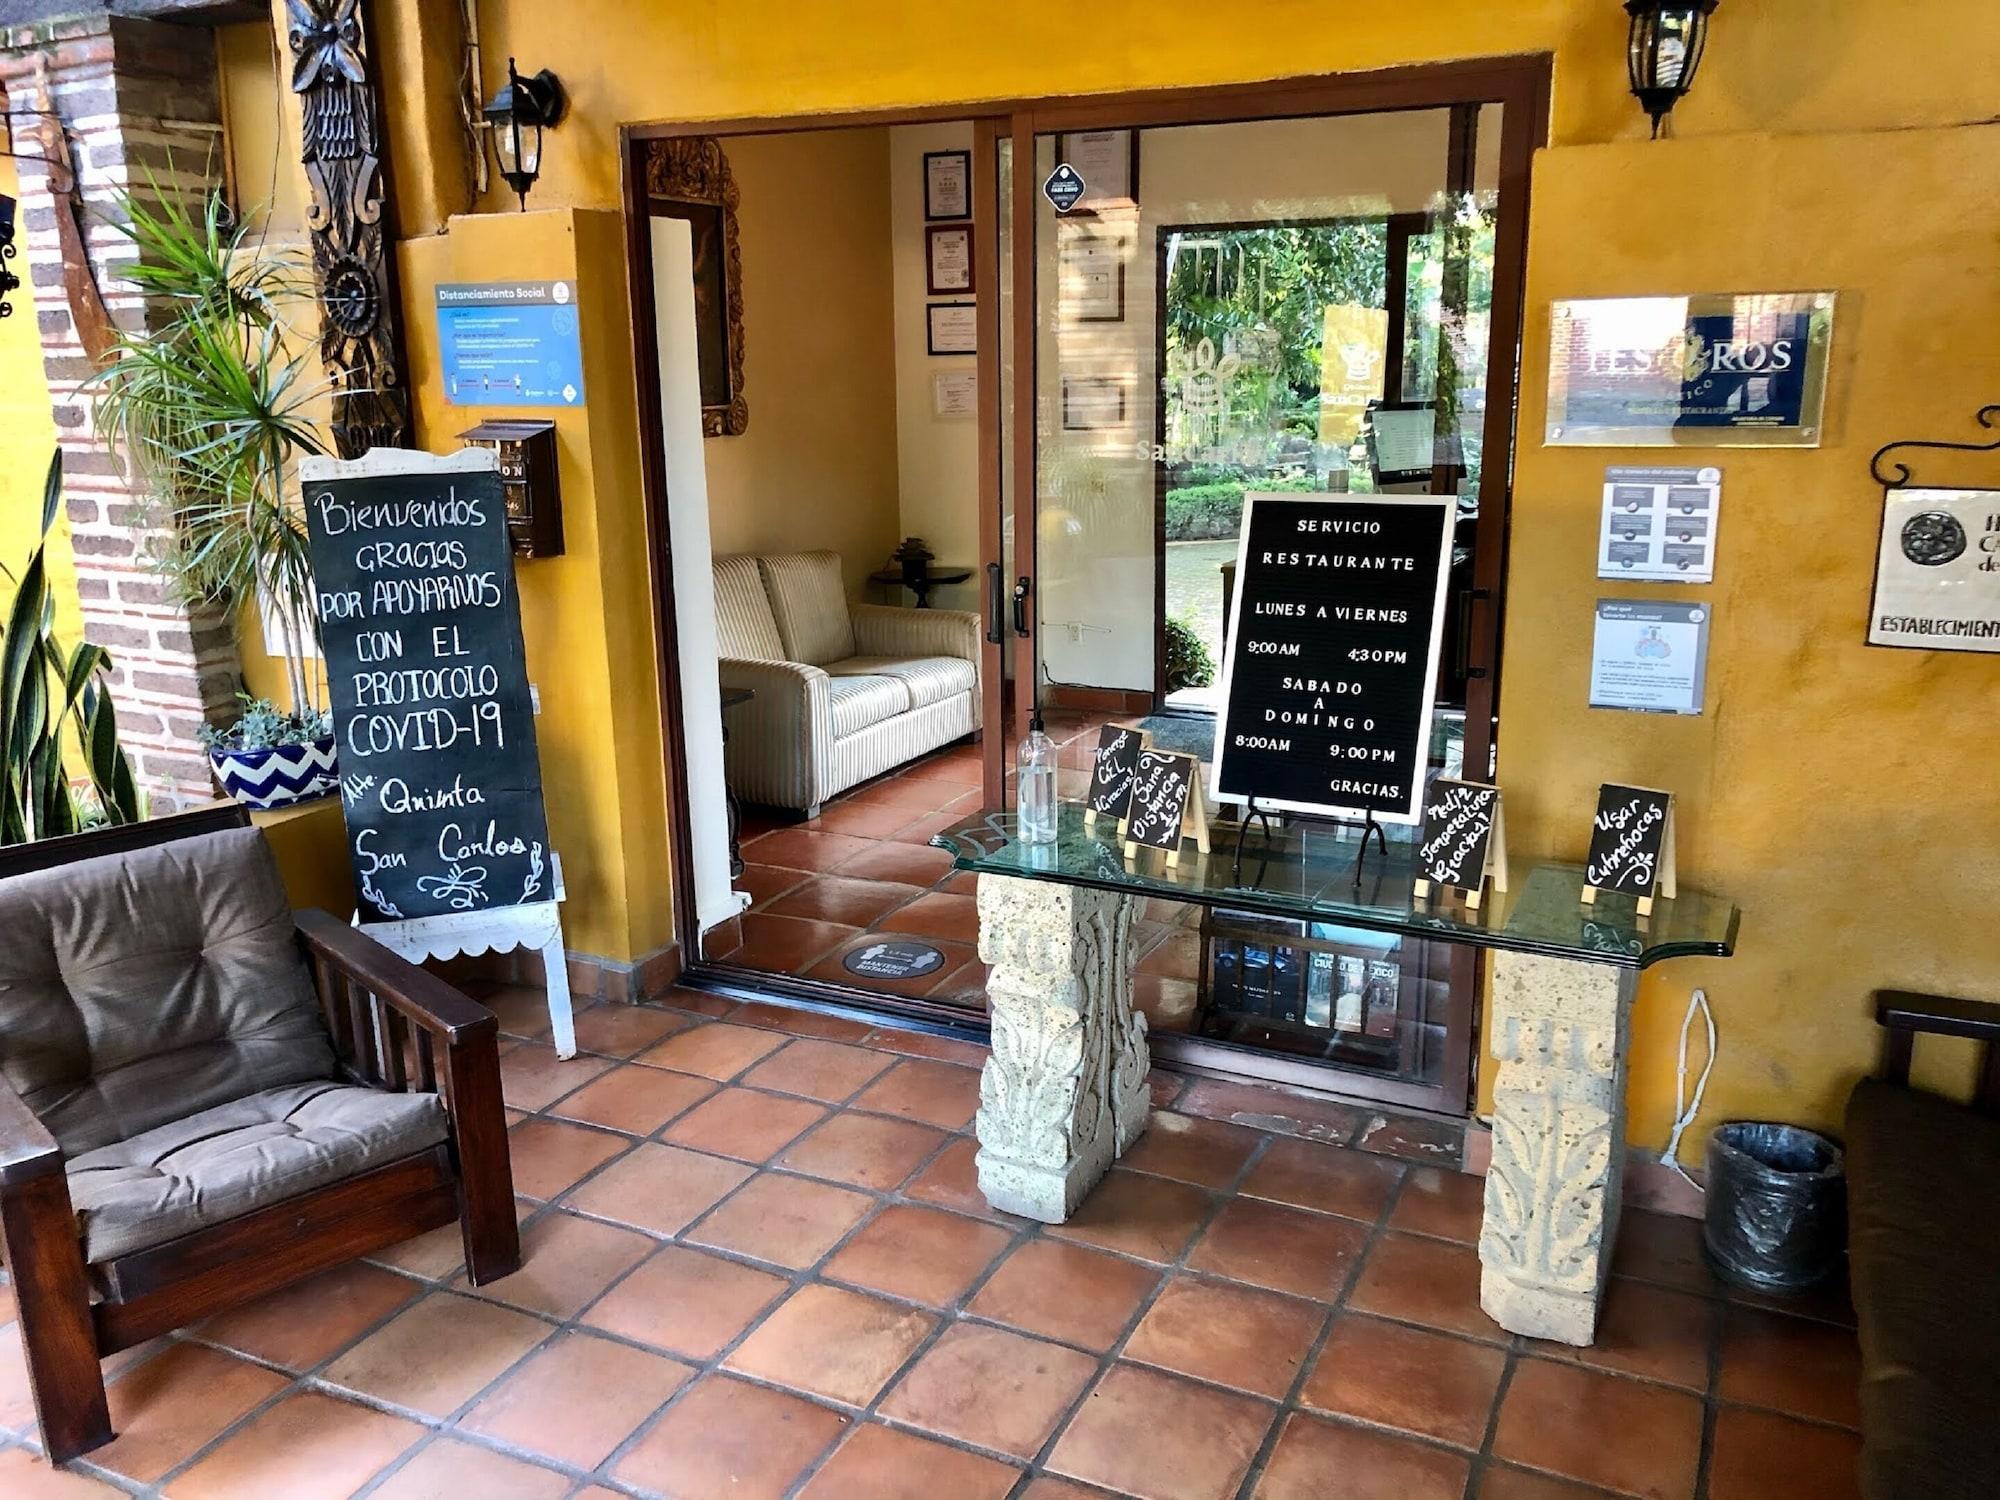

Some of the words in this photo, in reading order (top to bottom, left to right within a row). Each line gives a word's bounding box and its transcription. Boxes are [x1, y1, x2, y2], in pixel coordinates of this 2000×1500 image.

[439, 289, 515, 301] Distanciamiento
[516, 286, 546, 298] Social
[314, 486, 487, 536] Bienvenidos
[1297, 519, 1381, 534] SERVICIO
[1262, 552, 1414, 571] RESTAURANTE
[320, 591, 365, 623] POR
[372, 571, 501, 616] APOYARNOS
[1255, 602, 1306, 616] LUNES
[1317, 605, 1327, 619] A
[1335, 607, 1408, 624] VIERNES
[1879, 615, 2000, 638] ESTABLECIMIENT
[355, 630, 403, 662] CON
[432, 625, 470, 658] EL
[352, 664, 499, 708] PROTOCOLO
[1282, 676, 1362, 695] SABADO
[1265, 708, 1375, 731] DOMINGO
[1313, 697, 1324, 710] A
[347, 701, 504, 757] COVID-19
[1098, 756, 1126, 785] GEL
[1133, 765, 1165, 804] Sana
[379, 773, 485, 813] Quinta
[1132, 771, 1181, 840] Distancia
[1330, 779, 1404, 799] GRACIAS.
[1594, 798, 1640, 831] Usar
[355, 828, 407, 875] San
[438, 819, 528, 862] Carlos
[1587, 803, 1663, 885] Cubrebocas
